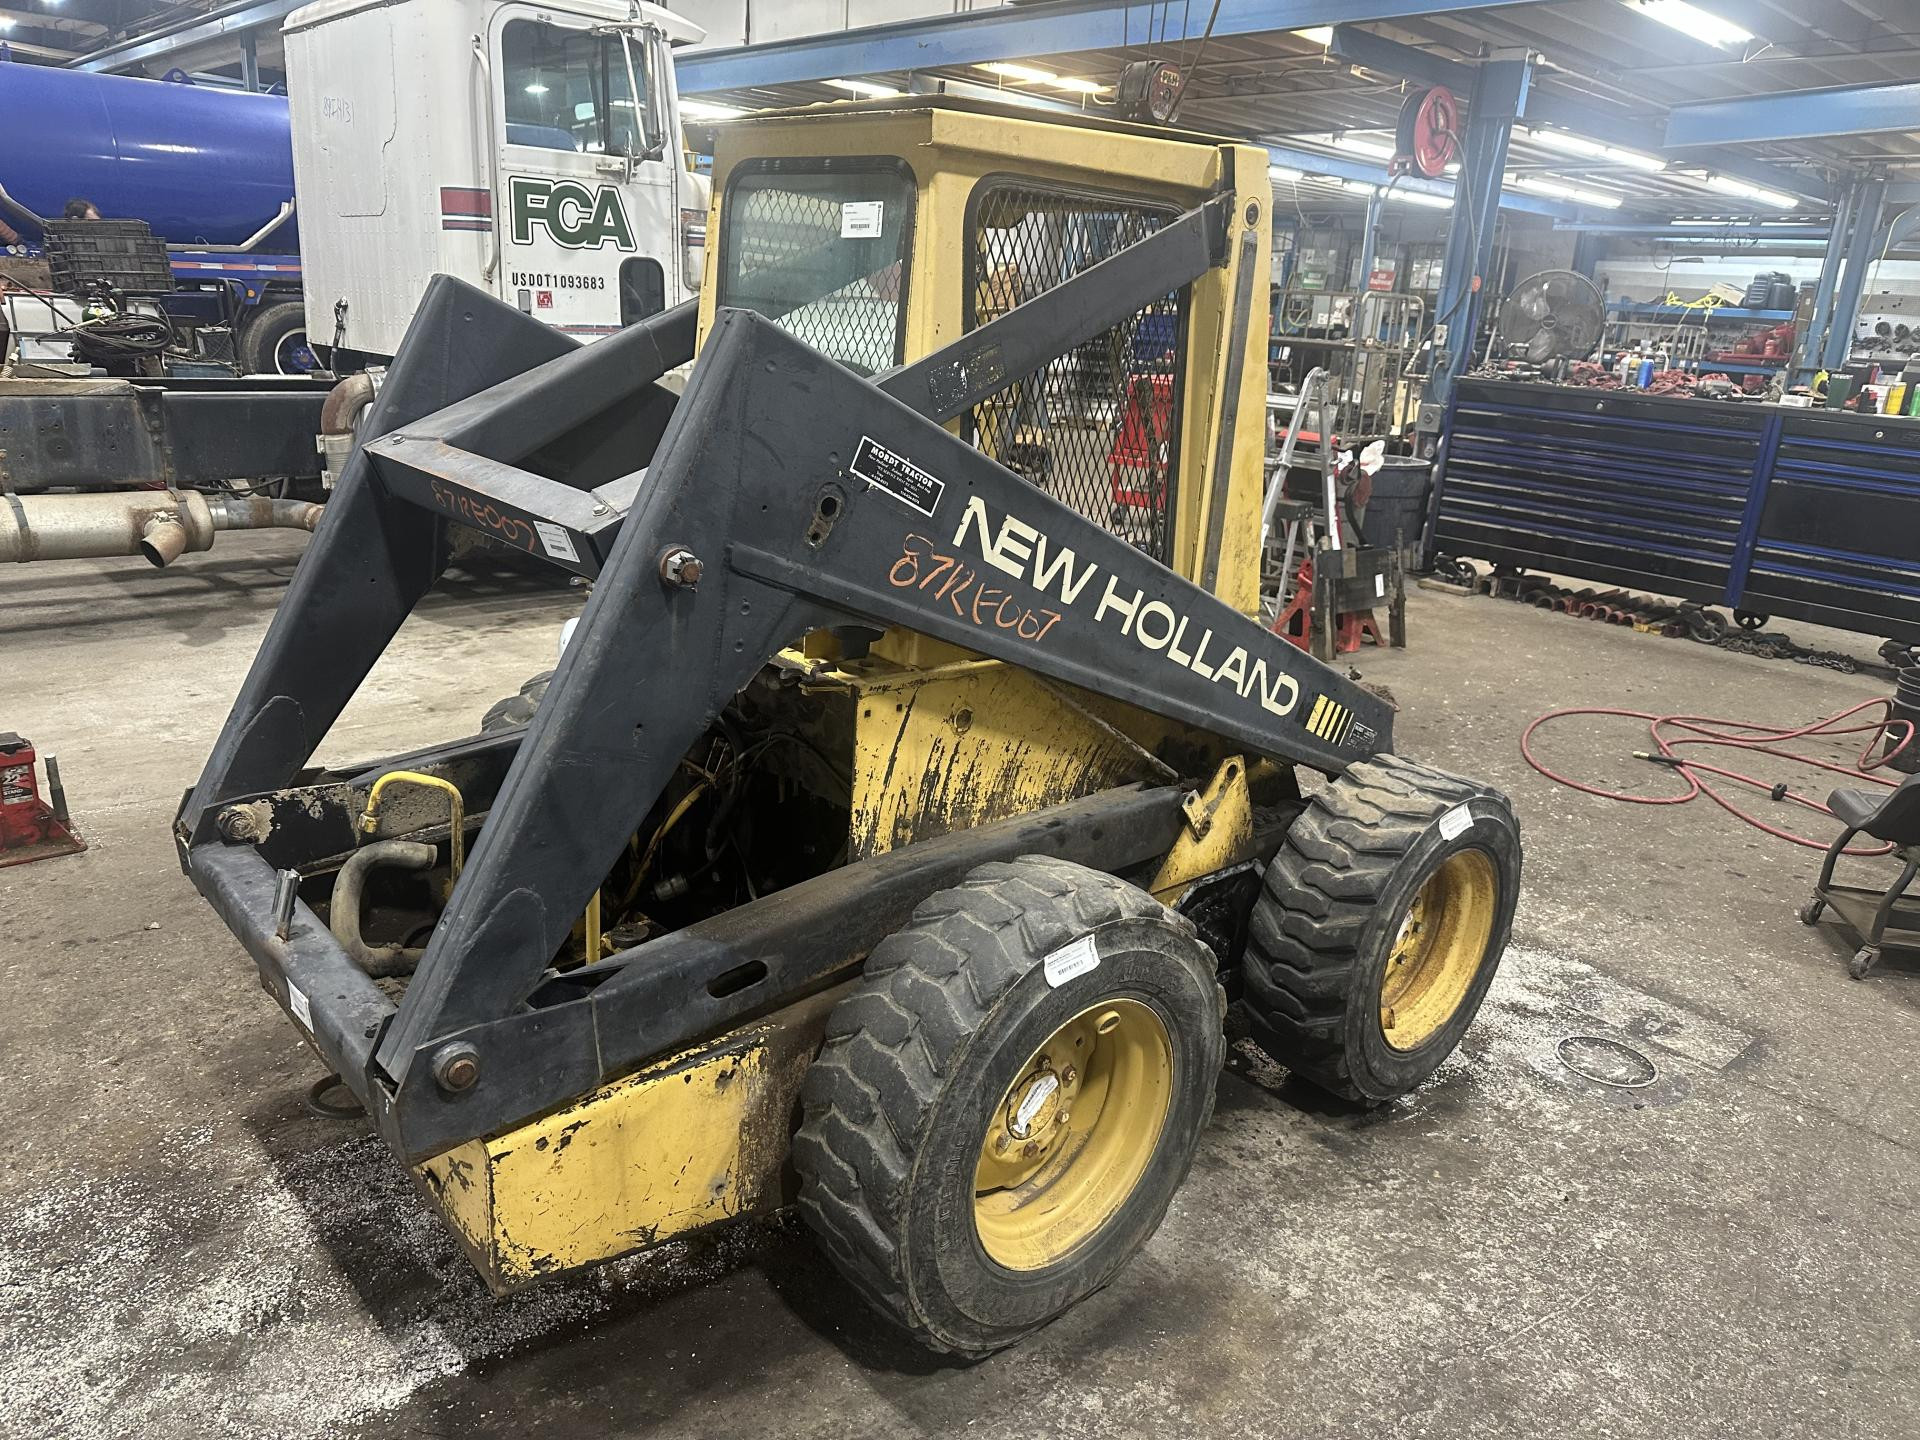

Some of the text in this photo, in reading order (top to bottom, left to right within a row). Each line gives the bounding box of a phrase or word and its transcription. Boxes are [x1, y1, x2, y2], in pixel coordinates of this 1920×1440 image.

[509, 175, 637, 252] FCA
[511, 272, 605, 290] USDOT1093683
[870, 446, 899, 467] MORDT
[901, 464, 933, 488] TRACTOR
[952, 496, 1299, 717] NEW HOLLAND
